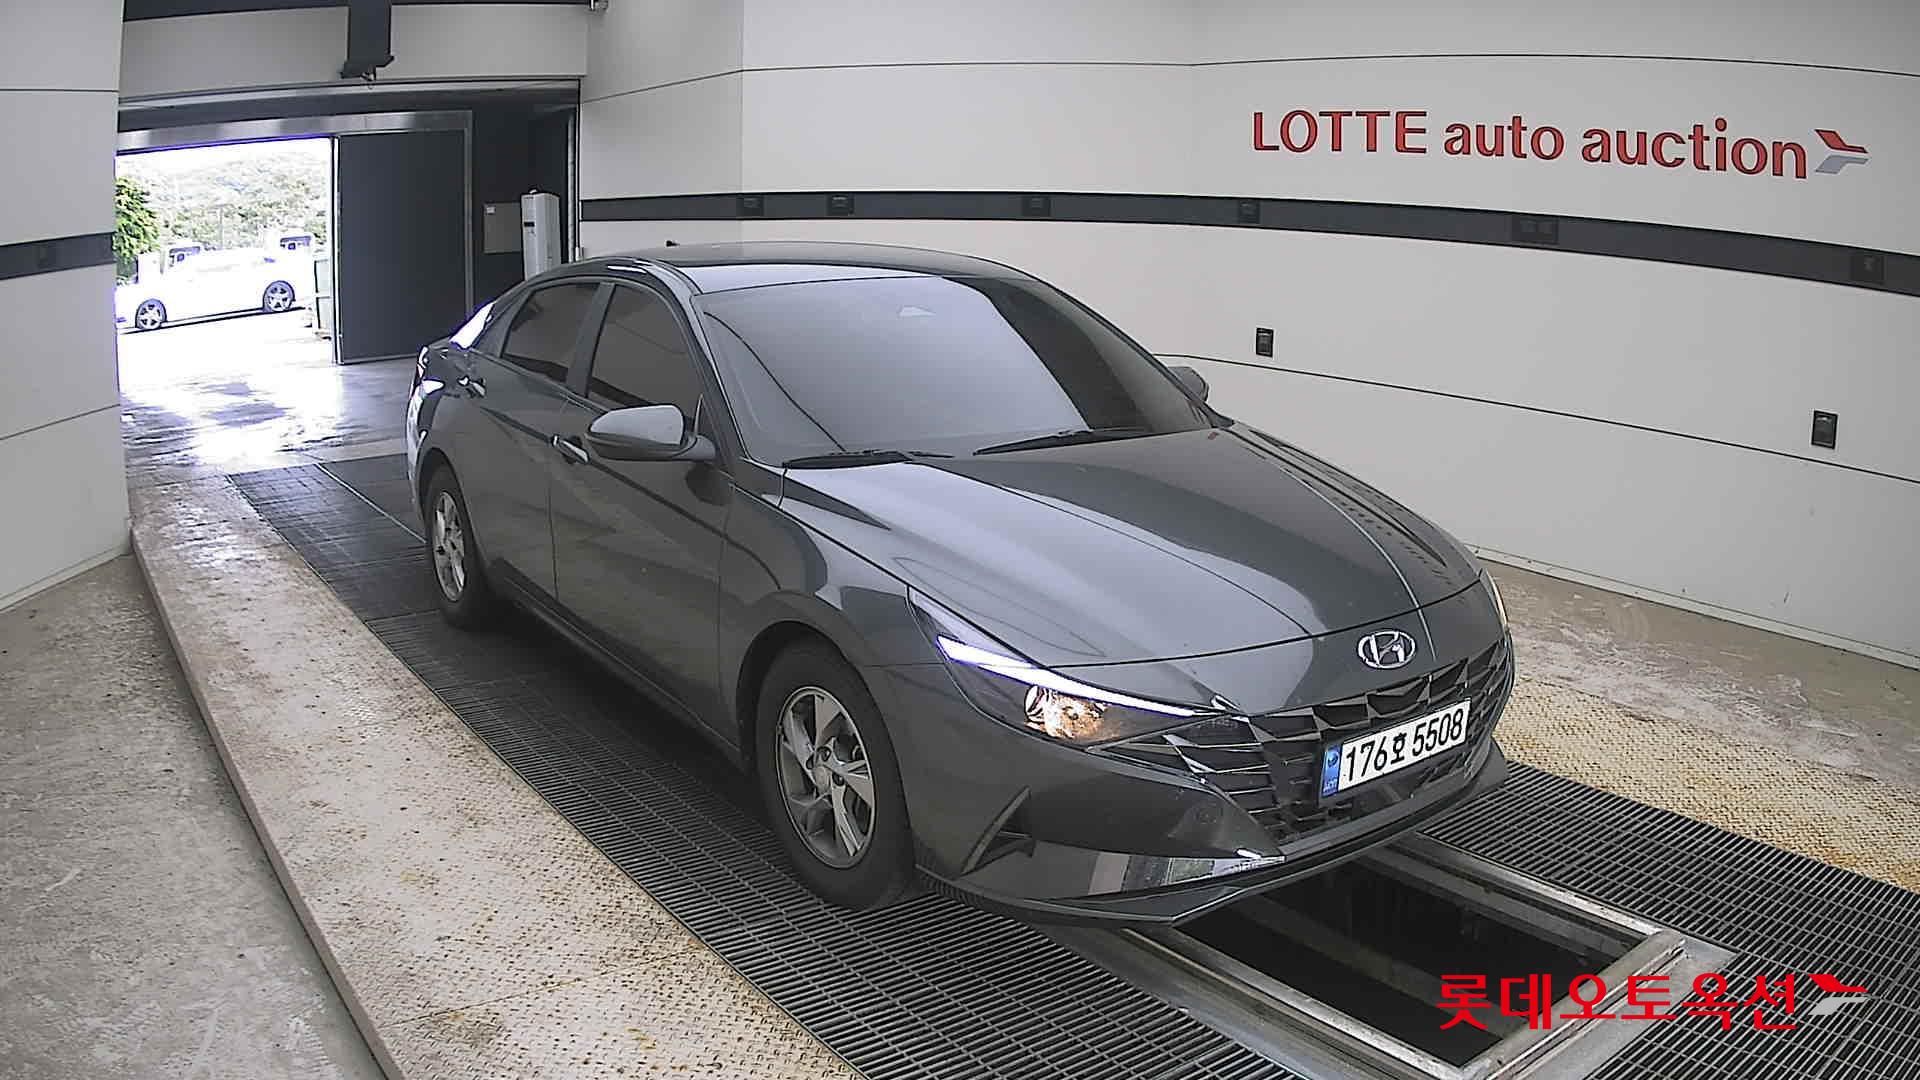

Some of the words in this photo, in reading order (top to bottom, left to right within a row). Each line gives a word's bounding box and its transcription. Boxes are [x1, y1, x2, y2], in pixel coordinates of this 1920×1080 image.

[1253, 110, 1427, 154] LOTTE
[1444, 115, 1564, 160] auto
[1582, 118, 1807, 179] auction
[1346, 731, 1408, 782] 176호
[1411, 708, 1464, 757] 5508
